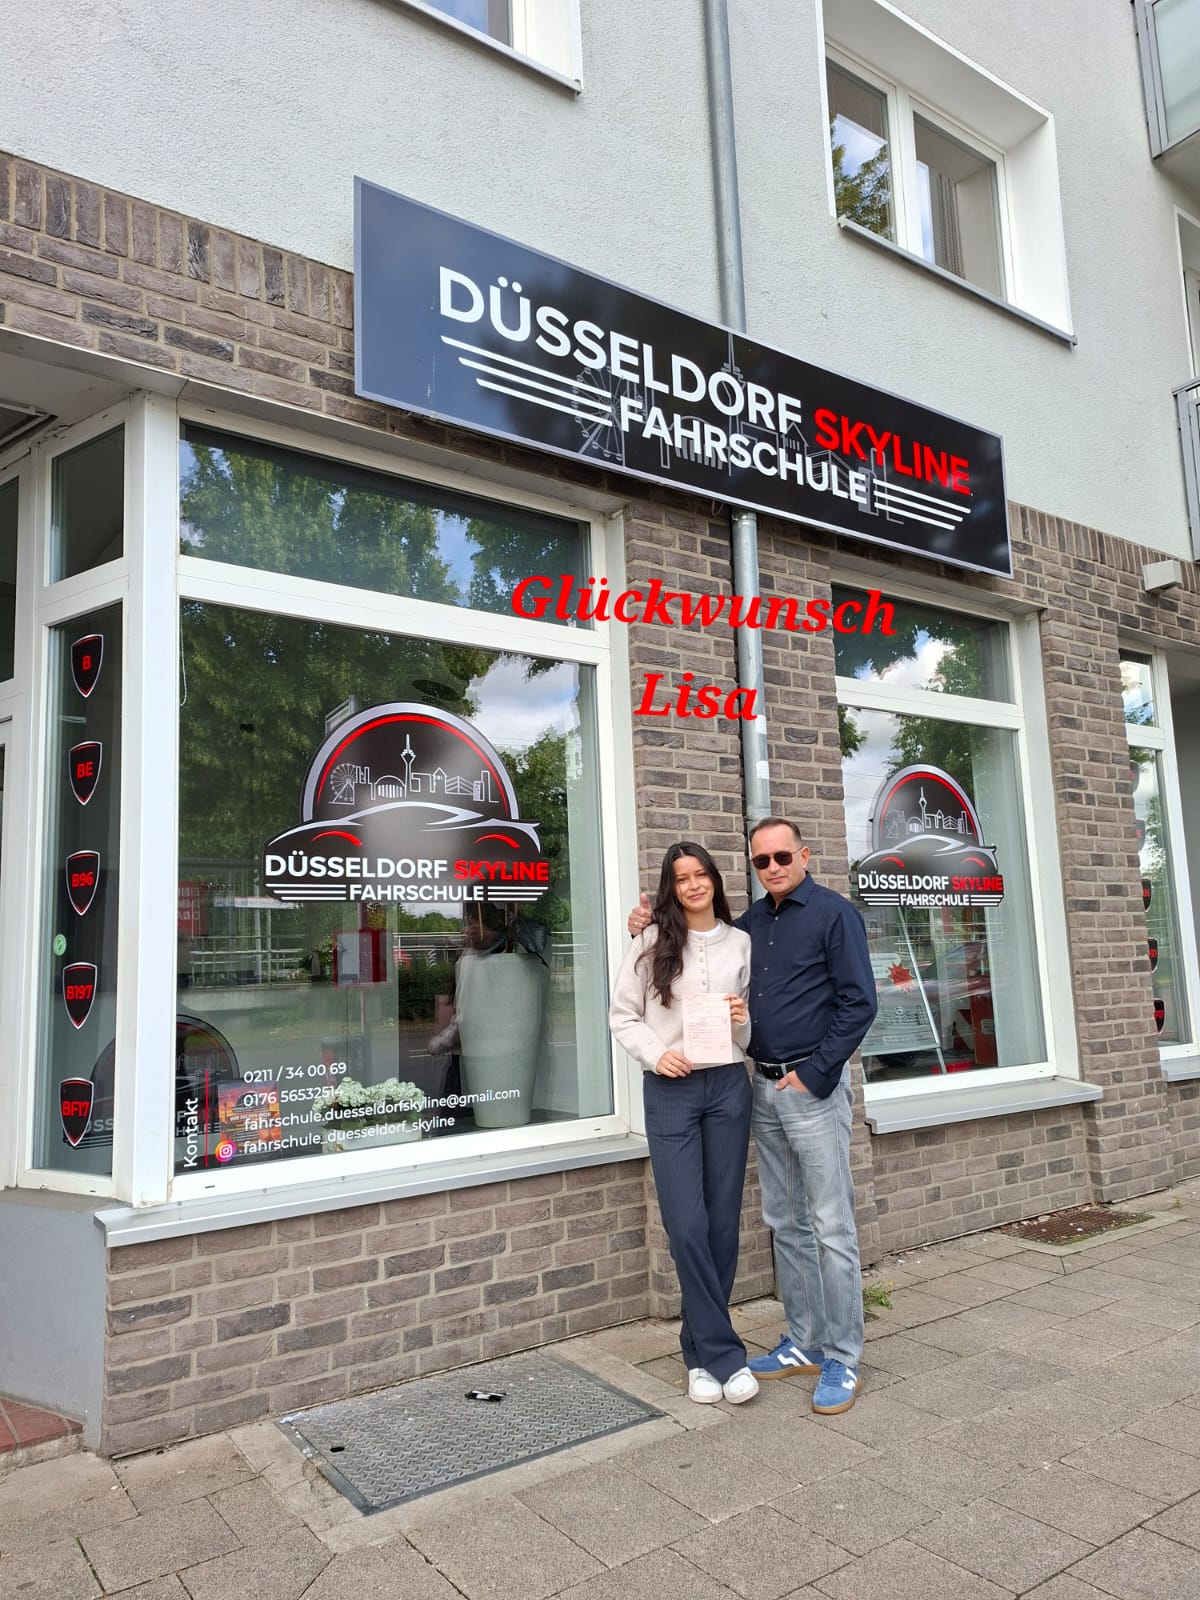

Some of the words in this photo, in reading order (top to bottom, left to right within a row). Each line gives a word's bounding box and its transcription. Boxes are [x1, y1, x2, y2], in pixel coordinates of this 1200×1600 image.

[439, 265, 802, 434] DÜSSELDORF
[813, 408, 971, 496] SKYLINE
[620, 394, 868, 505] FAHRSCHULE
[81, 655, 92, 671] B
[76, 761, 94, 778] BE
[265, 850, 448, 879] DÜSSELDORF
[454, 860, 549, 881] SKYLINE
[71, 872, 94, 888] B96
[858, 870, 949, 890] DÜSSELDORF
[952, 875, 1003, 892] SKYLINE
[350, 884, 484, 901] FAHRSCHULE
[900, 893, 970, 906] FAHRSCHULE
[66, 984, 93, 1000] B197
[243, 1069, 273, 1084] 0211
[276, 1065, 284, 1082] /
[286, 1066, 304, 1080] 34
[307, 1064, 326, 1077] 00
[329, 1062, 347, 1074] 69
[243, 1092, 277, 1107] 0176
[280, 1085, 345, 1103] 56532514
[62, 1101, 90, 1117] BF17
[244, 1089, 520, 1132] fahrschule.duesseldorfskyline@gmail.com
[183, 1097, 199, 1167] Kontakt
[243, 1116, 456, 1154] fahrschule_duesseldorf_skyline
